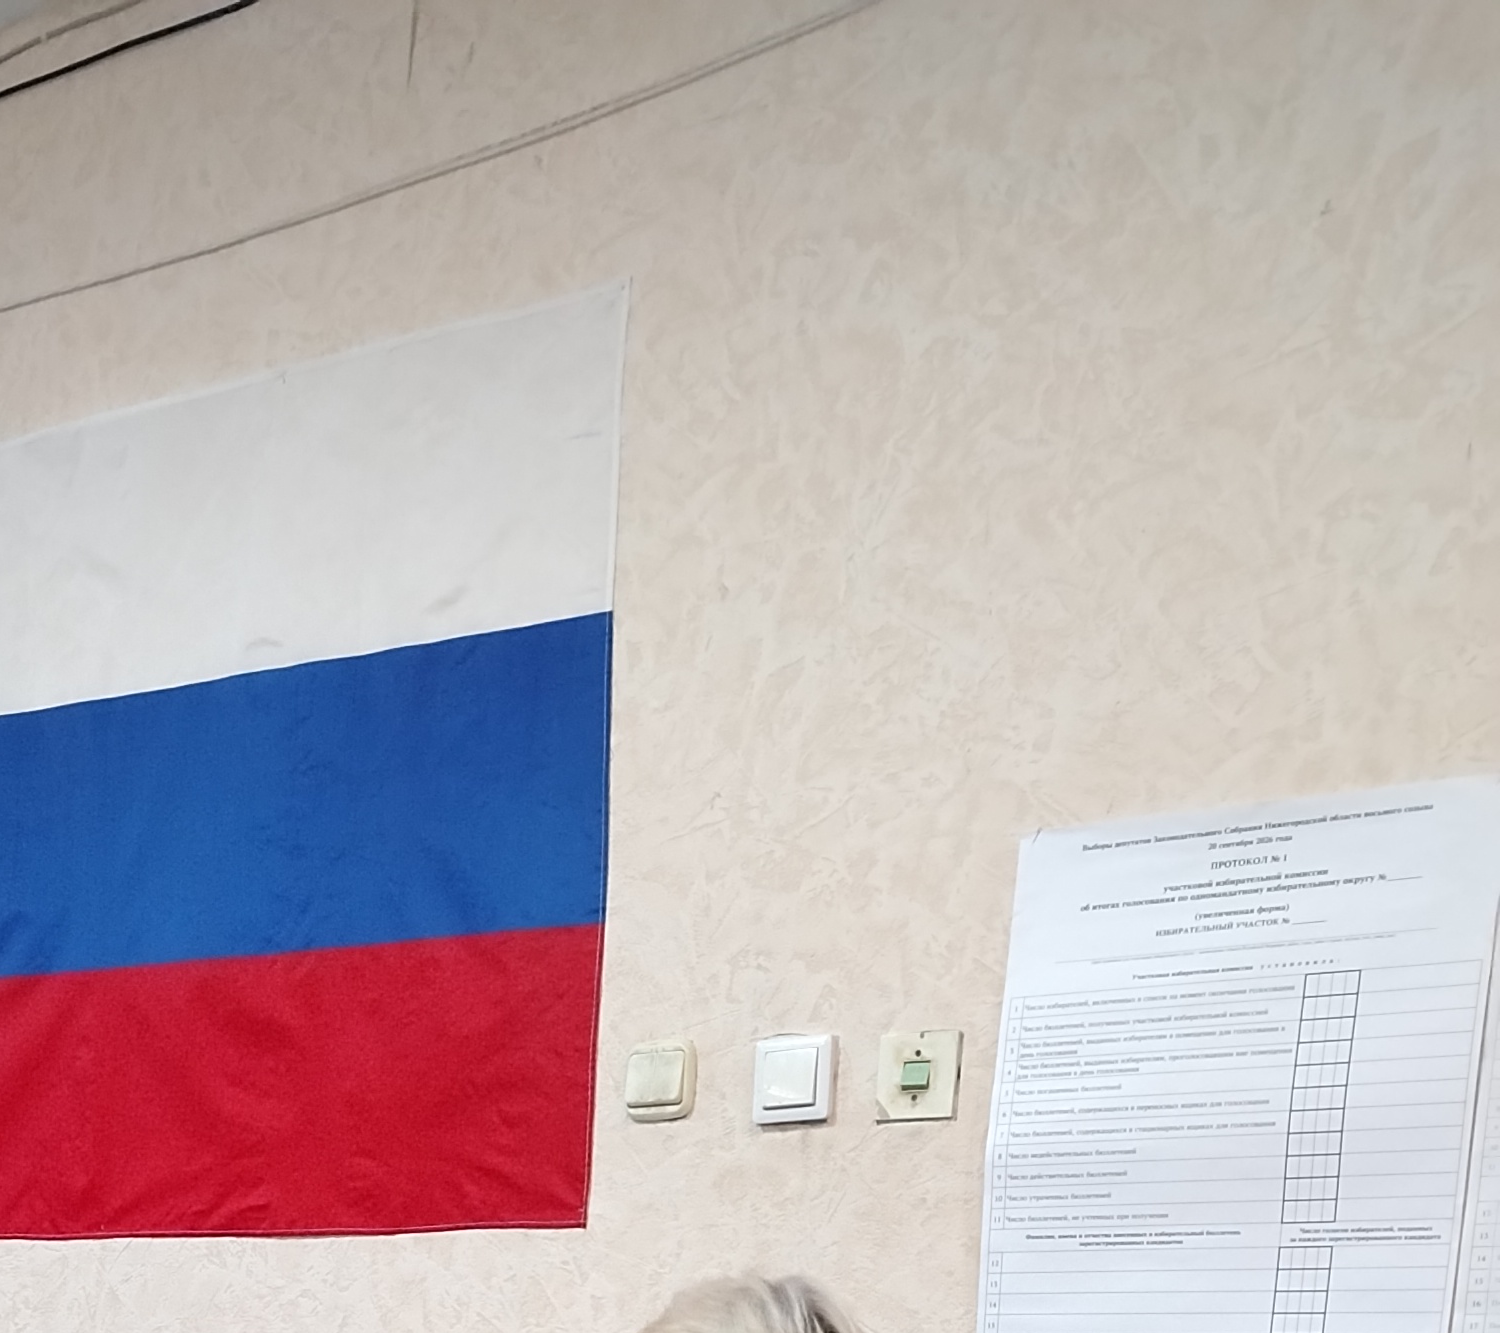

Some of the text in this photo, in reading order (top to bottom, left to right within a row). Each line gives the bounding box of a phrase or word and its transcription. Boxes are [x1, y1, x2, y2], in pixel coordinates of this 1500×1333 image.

[1210, 856, 1268, 870] ПРОТОКОЛ
[1214, 873, 1282, 887] избирательной
[1342, 876, 1374, 885] округу
[1256, 904, 1290, 915] форма)
[1156, 922, 1234, 937] ИЗБИРАТЕЛЬНЫЙ
[1235, 918, 1279, 930] УЧАСТОК
